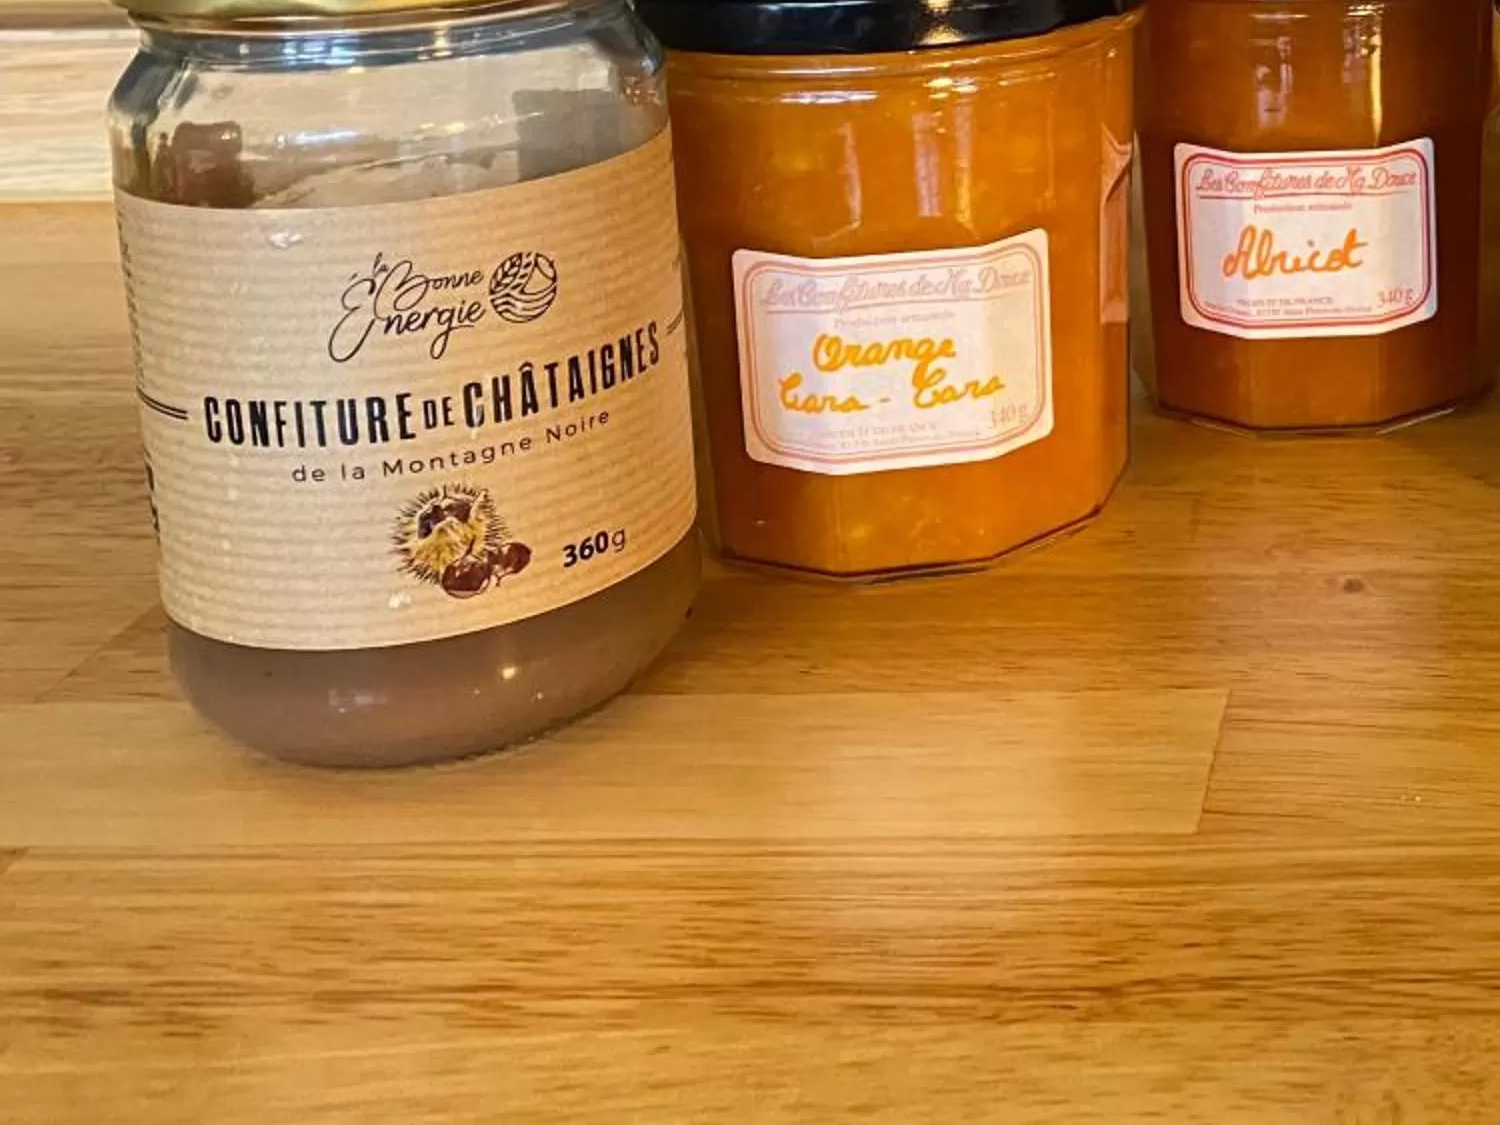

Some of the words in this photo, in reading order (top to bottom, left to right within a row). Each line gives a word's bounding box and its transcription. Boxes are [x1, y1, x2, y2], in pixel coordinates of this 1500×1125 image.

[1196, 168, 1222, 191] Les
[1221, 224, 1368, 281] Abricot
[373, 260, 485, 321] Bonne
[204, 392, 417, 448] CONFITURE
[423, 395, 454, 430] DE
[463, 320, 660, 428] CHÂTAIGNES
[812, 333, 957, 387] Orange
[291, 465, 325, 482] de
[341, 463, 366, 482] la
[382, 434, 532, 478] Montagne
[546, 408, 610, 444] Noire
[561, 527, 626, 568] 360g
